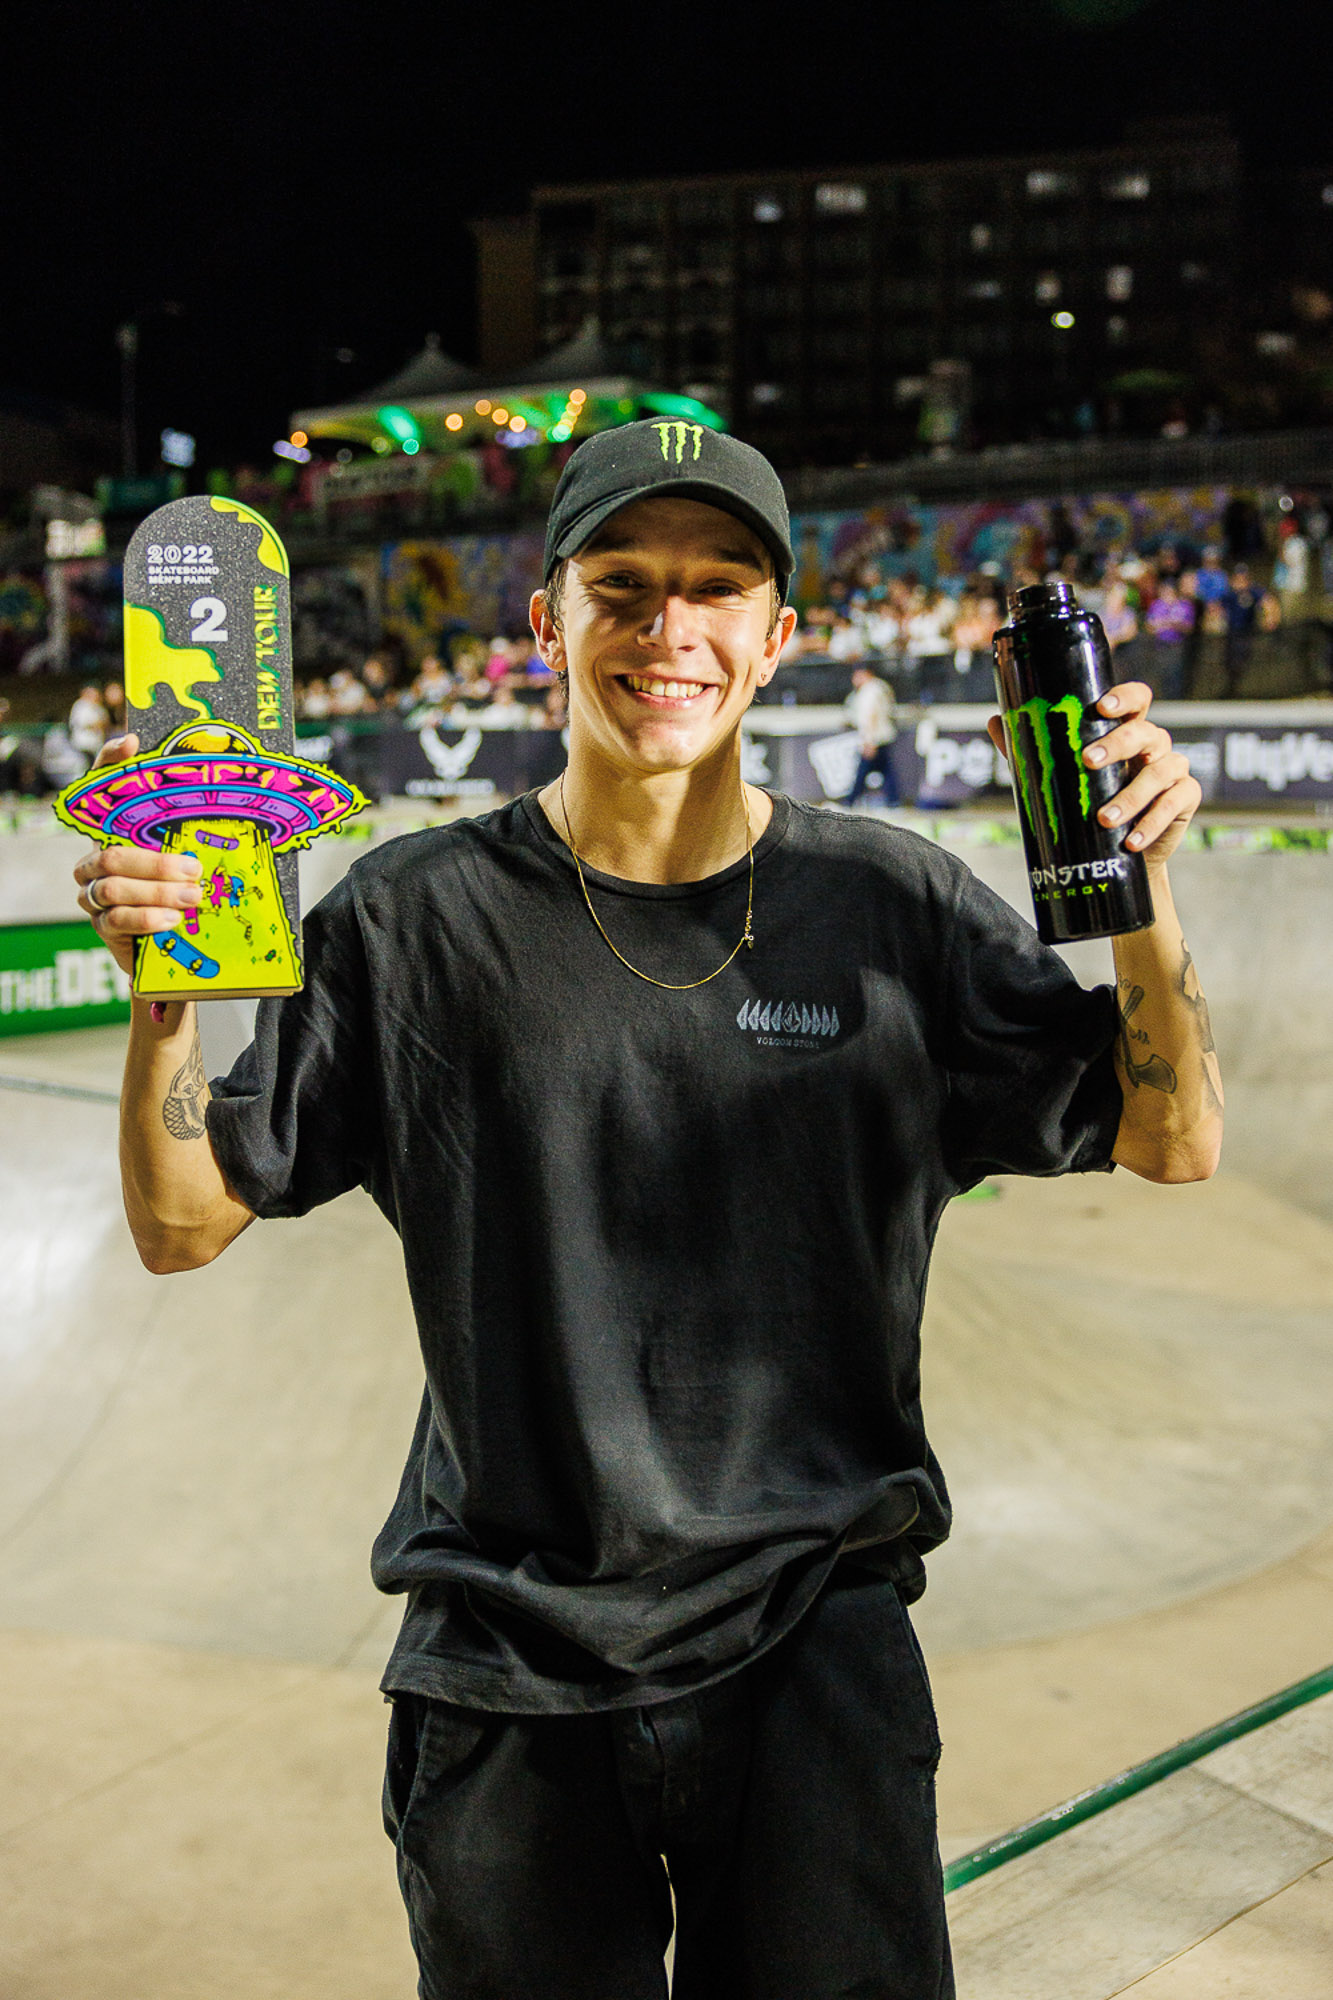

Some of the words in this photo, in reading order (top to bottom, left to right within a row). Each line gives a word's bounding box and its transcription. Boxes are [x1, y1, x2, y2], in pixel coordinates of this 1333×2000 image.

[147, 544, 213, 564] 2022
[148, 565, 219, 575] SKATEBOARD
[148, 575, 182, 585] MEN'S
[183, 575, 212, 585] PARK
[189, 596, 228, 642] 2
[1030, 858, 1127, 891] ONSTER
